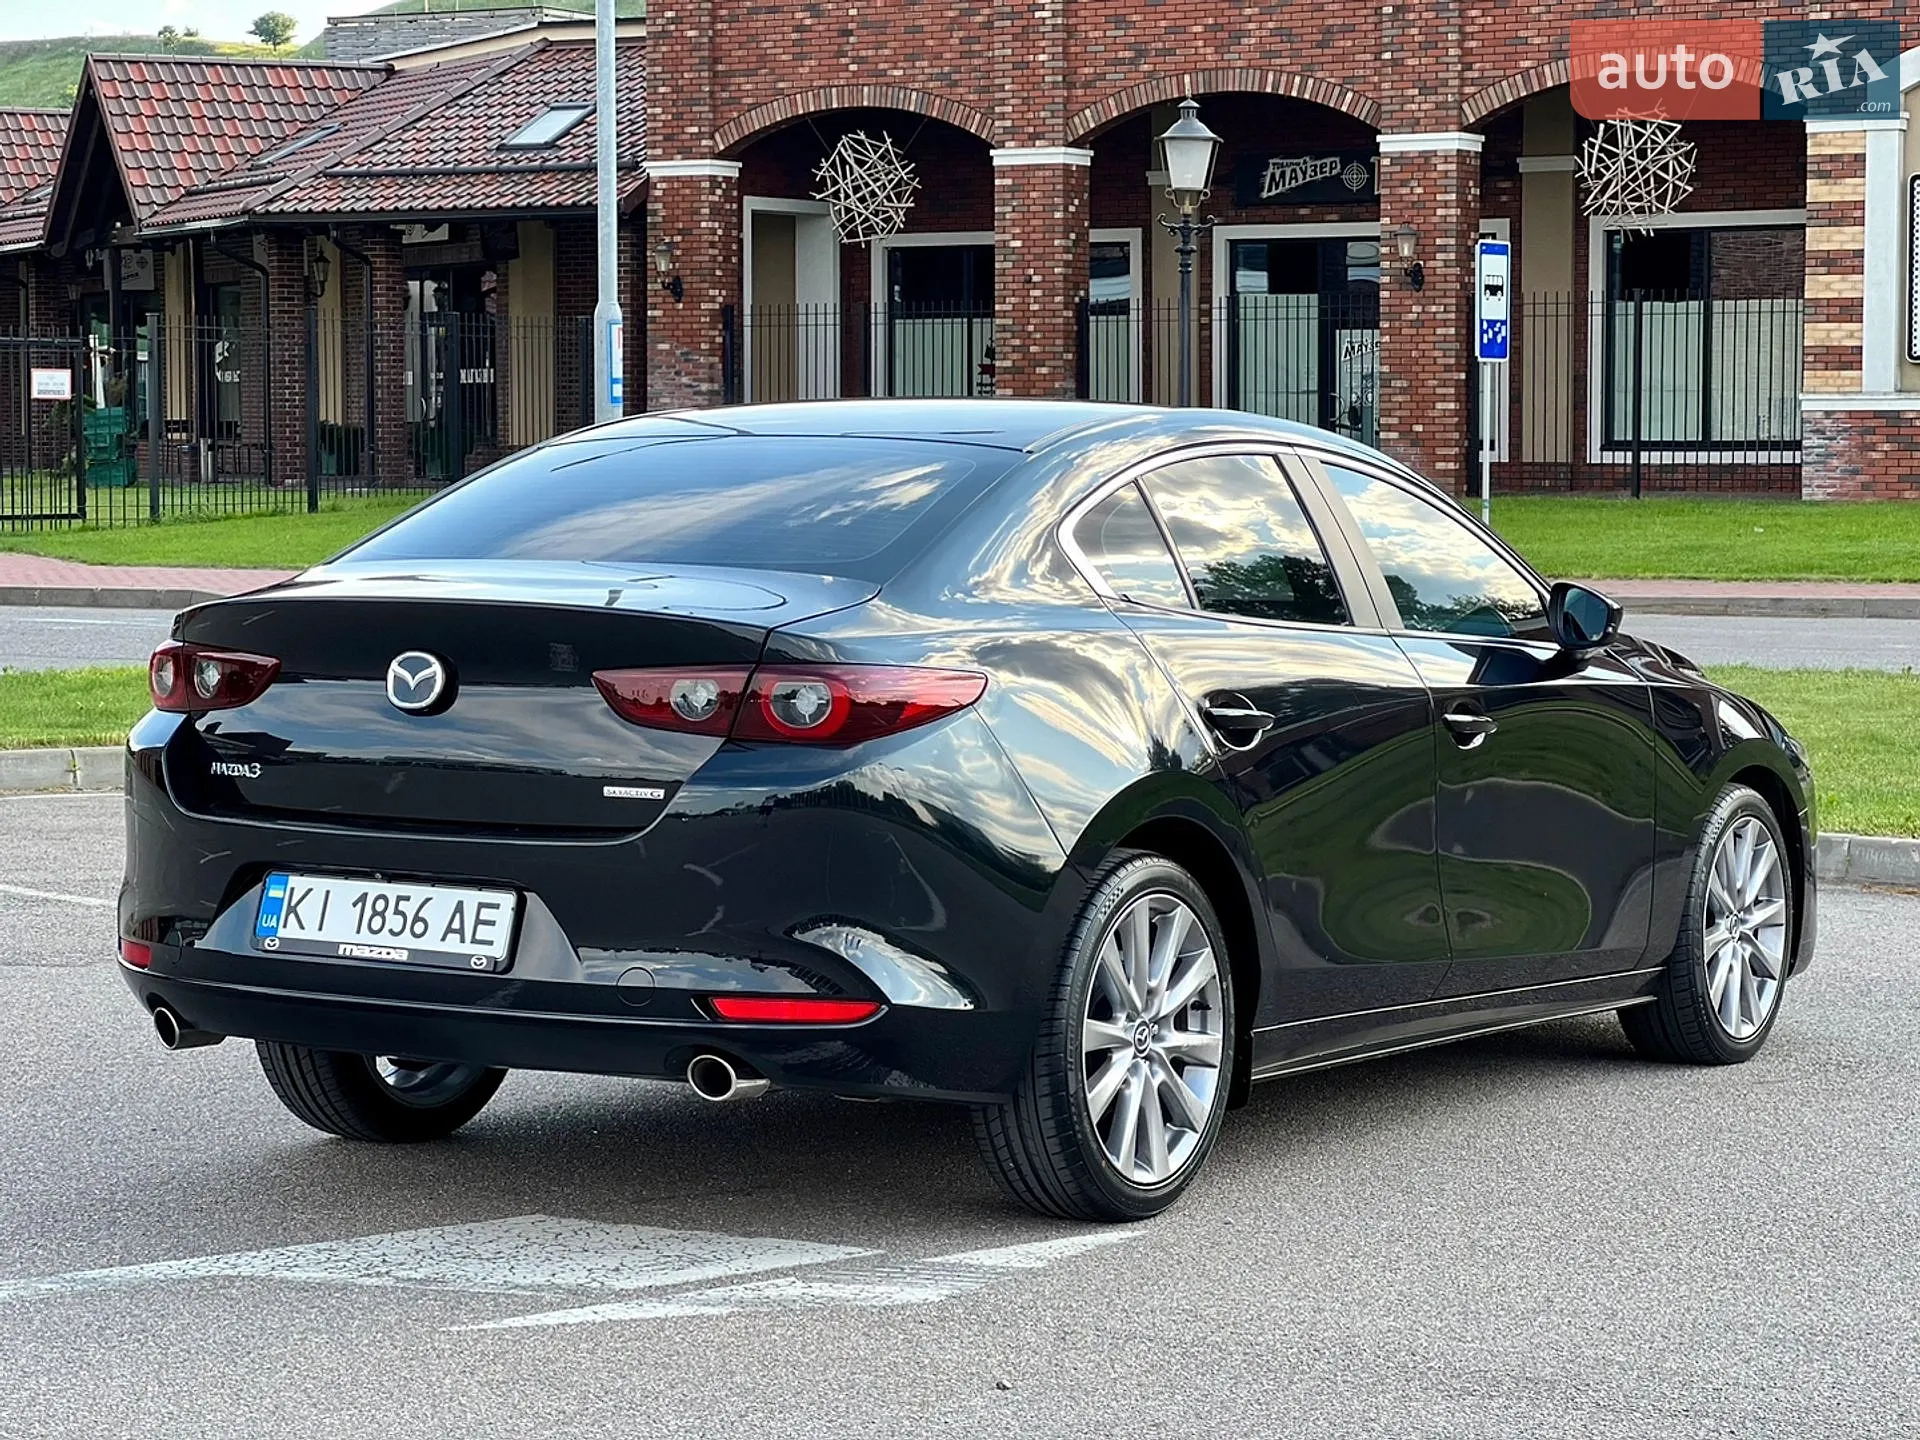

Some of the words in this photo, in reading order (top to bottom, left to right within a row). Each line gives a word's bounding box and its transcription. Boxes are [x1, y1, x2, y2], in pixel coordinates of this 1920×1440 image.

[261, 914, 278, 929] UA
[282, 886, 331, 931] KI
[351, 891, 434, 939] 1856
[440, 899, 501, 947] AE
[337, 944, 409, 961] mazda
